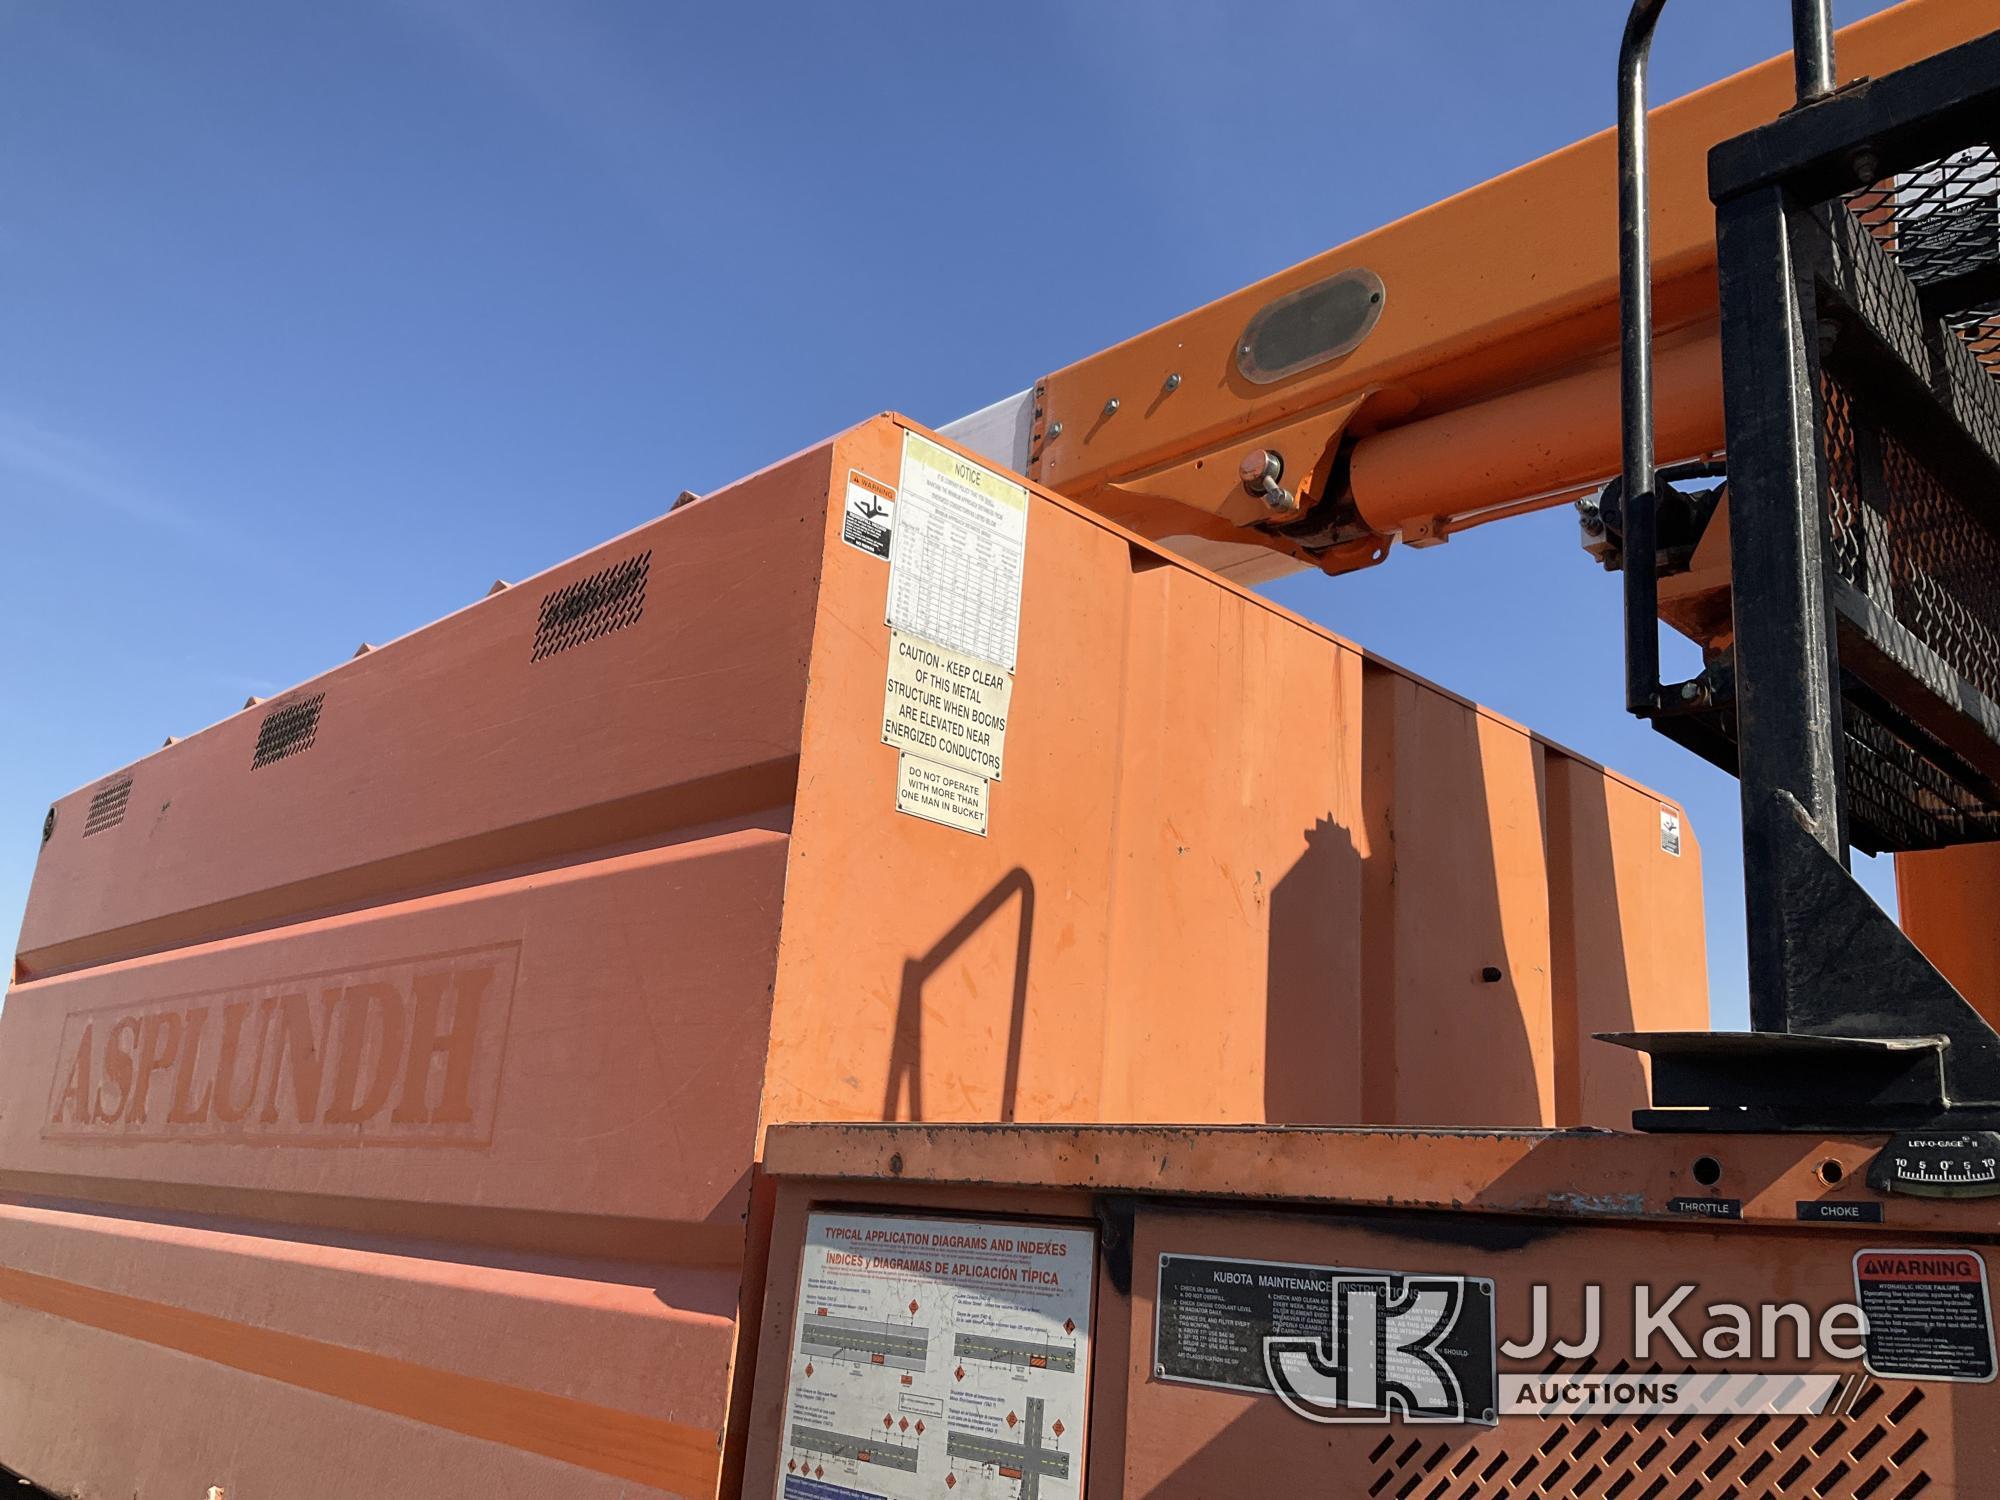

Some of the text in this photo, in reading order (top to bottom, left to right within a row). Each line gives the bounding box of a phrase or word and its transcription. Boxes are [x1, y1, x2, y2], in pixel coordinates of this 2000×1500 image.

[862, 479, 893, 499] WARNING
[955, 463, 981, 486] NOTICE
[899, 643, 940, 668] CAUTION
[946, 660, 971, 679] KEEP
[972, 669, 1004, 690] CLEAR
[888, 678, 941, 709] STRUCTURE
[943, 698, 970, 719] WHEN
[915, 669, 982, 704] OF THIS METAL
[899, 704, 990, 746] ARE ELEVATED NEAR
[885, 719, 1001, 769] ENERGIZED CONDUCTORS
[908, 779, 979, 808] WITH MORE THAN
[909, 766, 979, 796] DO NOT OPERATE
[901, 789, 984, 821] ONE MAN IN BUCKET
[53, 966, 496, 1125] ASPLUNDH
[1895, 1158, 1907, 1167] 10
[1919, 1161, 1926, 1170] 5
[1963, 1161, 1971, 1170] 5
[1982, 1158, 1995, 1168] 10
[1679, 1202, 1729, 1213] THROTTLE
[1820, 1206, 1860, 1217] CHOKE
[825, 1227, 863, 1241] TYPICAL
[865, 1231, 930, 1246] APPLICATION
[932, 1235, 988, 1250] DIAGRAMS
[990, 1240, 1013, 1252] AND
[1016, 1241, 1067, 1257] INDEXES
[865, 1259, 872, 1269] y
[873, 1256, 932, 1274] DIAGRAMAS
[935, 1262, 949, 1275] DE
[951, 1263, 1018, 1281] APLICACIÓN
[1021, 1267, 1060, 1286] TÍPICA
[1214, 1271, 1253, 1285] KUBOTA
[1259, 1275, 1332, 1293] MAINTENANCE
[1879, 1260, 1972, 1276] WARNING
